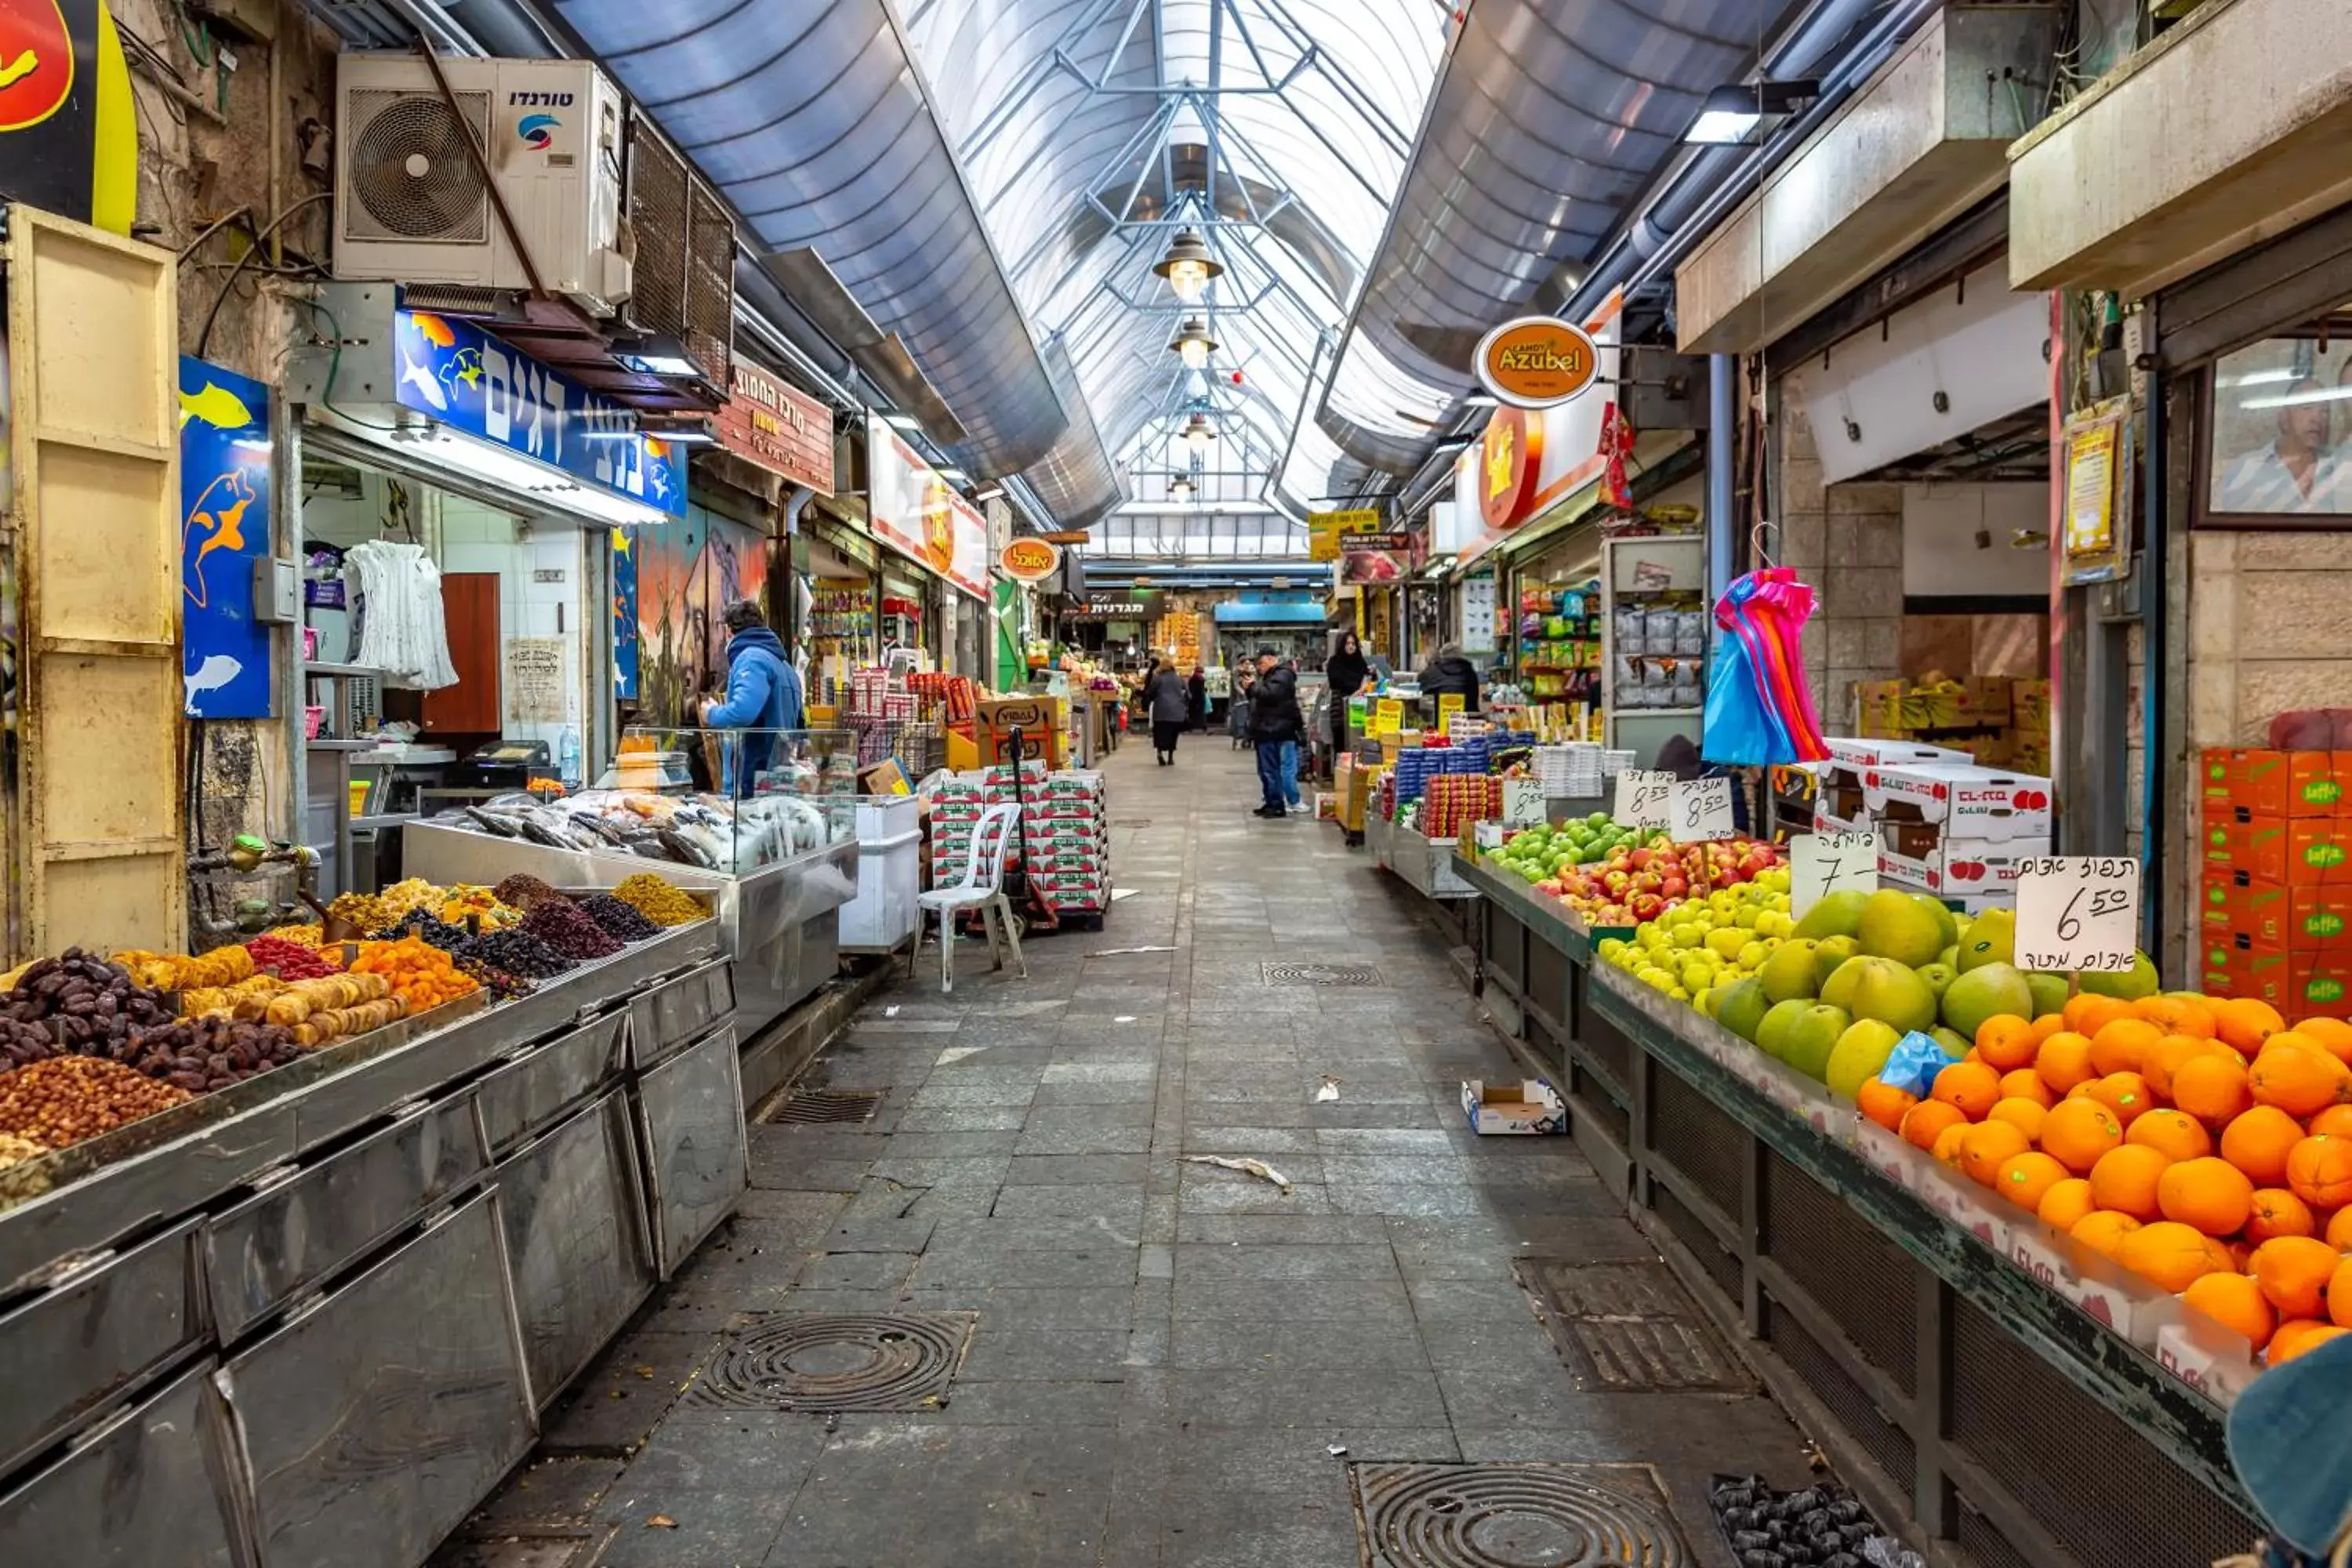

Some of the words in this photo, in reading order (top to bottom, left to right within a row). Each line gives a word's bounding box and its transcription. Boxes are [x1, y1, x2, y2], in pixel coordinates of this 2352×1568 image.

[509, 91, 574, 107] טורנדו
[1498, 347, 1582, 372] Azubel
[735, 369, 777, 408] החמוצ
[481, 339, 566, 465] דגים
[779, 393, 805, 434] מרכז
[1091, 602, 1145, 614] מגדנית
[1001, 710, 1035, 720] VIDAL
[2080, 858, 2134, 879] תפוז
